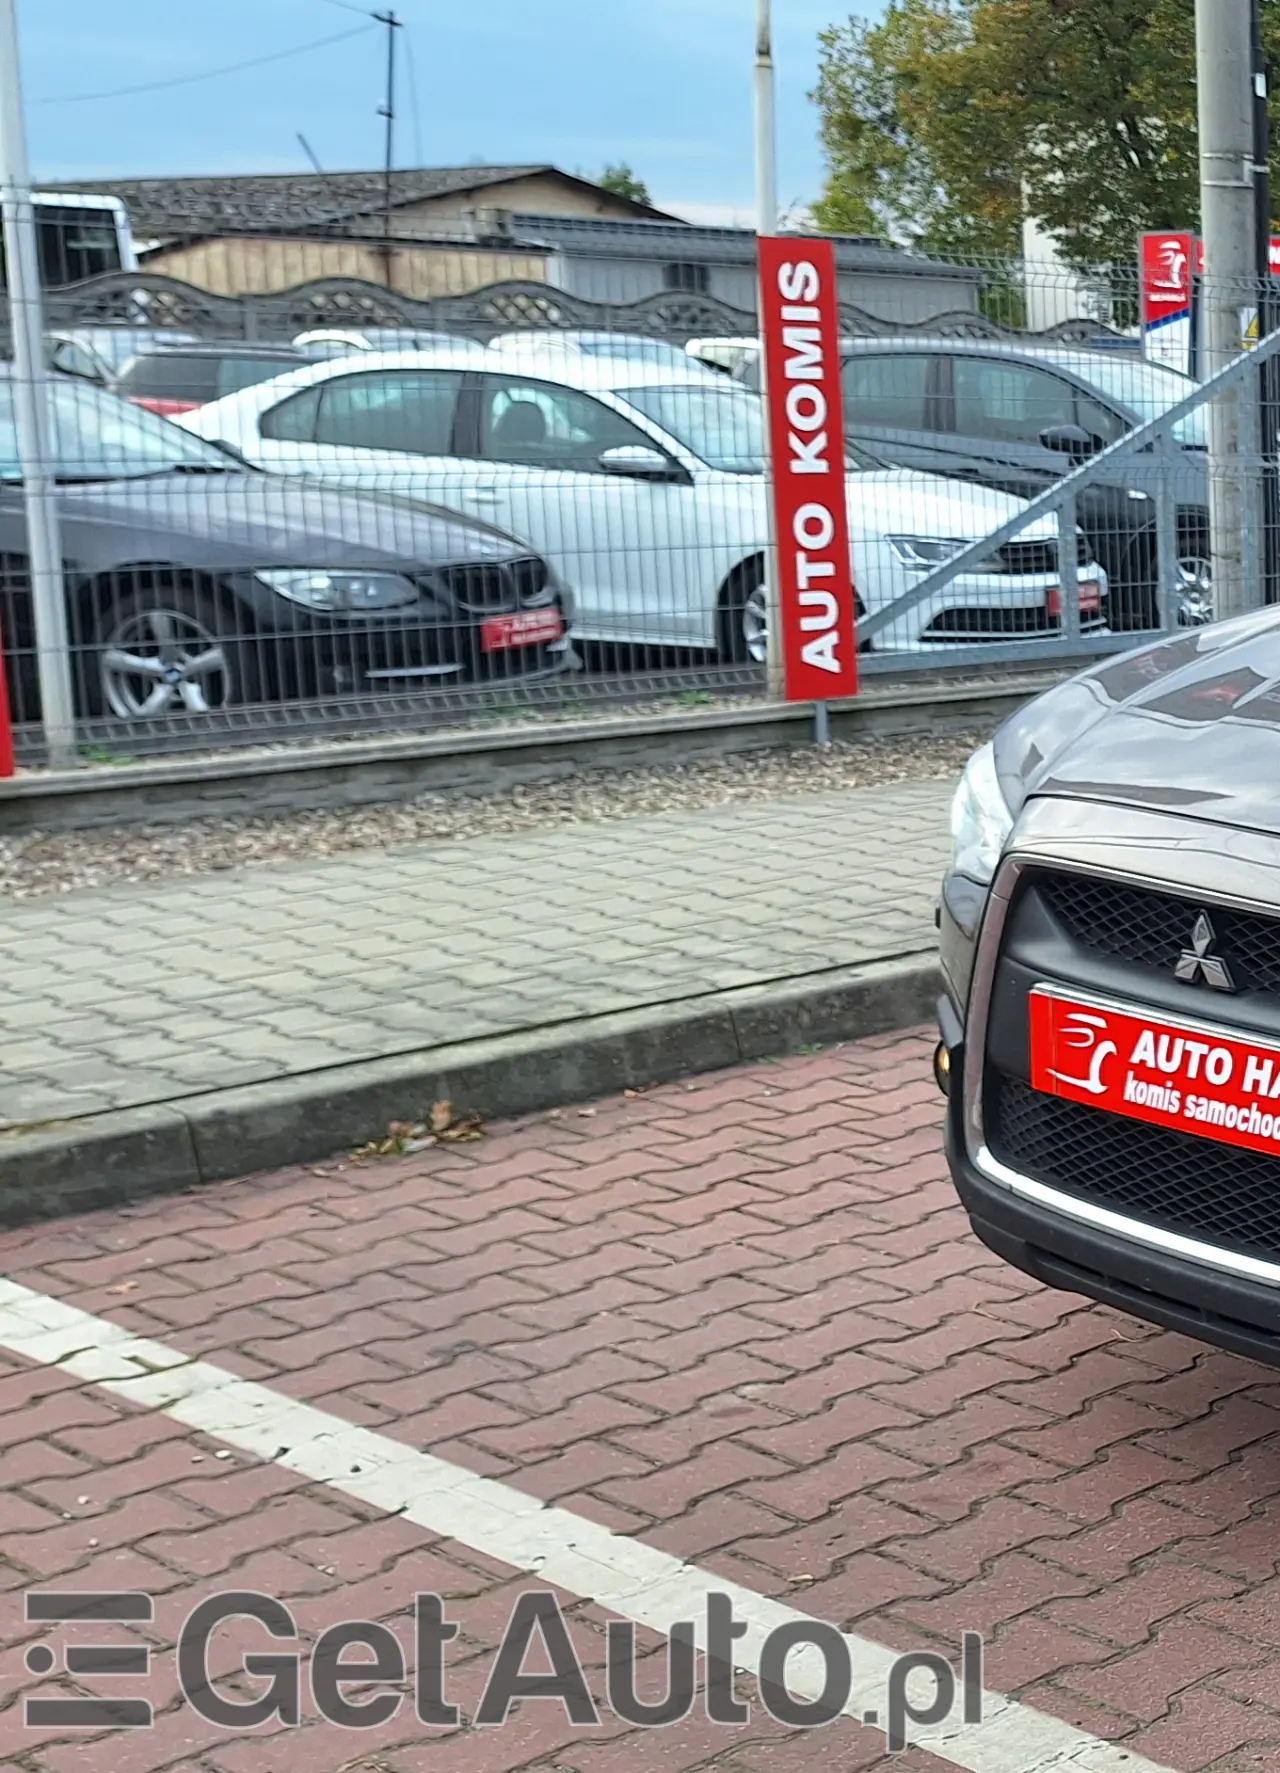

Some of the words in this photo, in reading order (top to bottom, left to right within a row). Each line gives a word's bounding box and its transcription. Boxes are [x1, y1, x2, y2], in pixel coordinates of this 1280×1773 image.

[777, 259, 831, 475] KOMIS
[792, 501, 843, 674] AUTO
[1123, 1069, 1183, 1115] komis
[1129, 1029, 1234, 1086] AUTO
